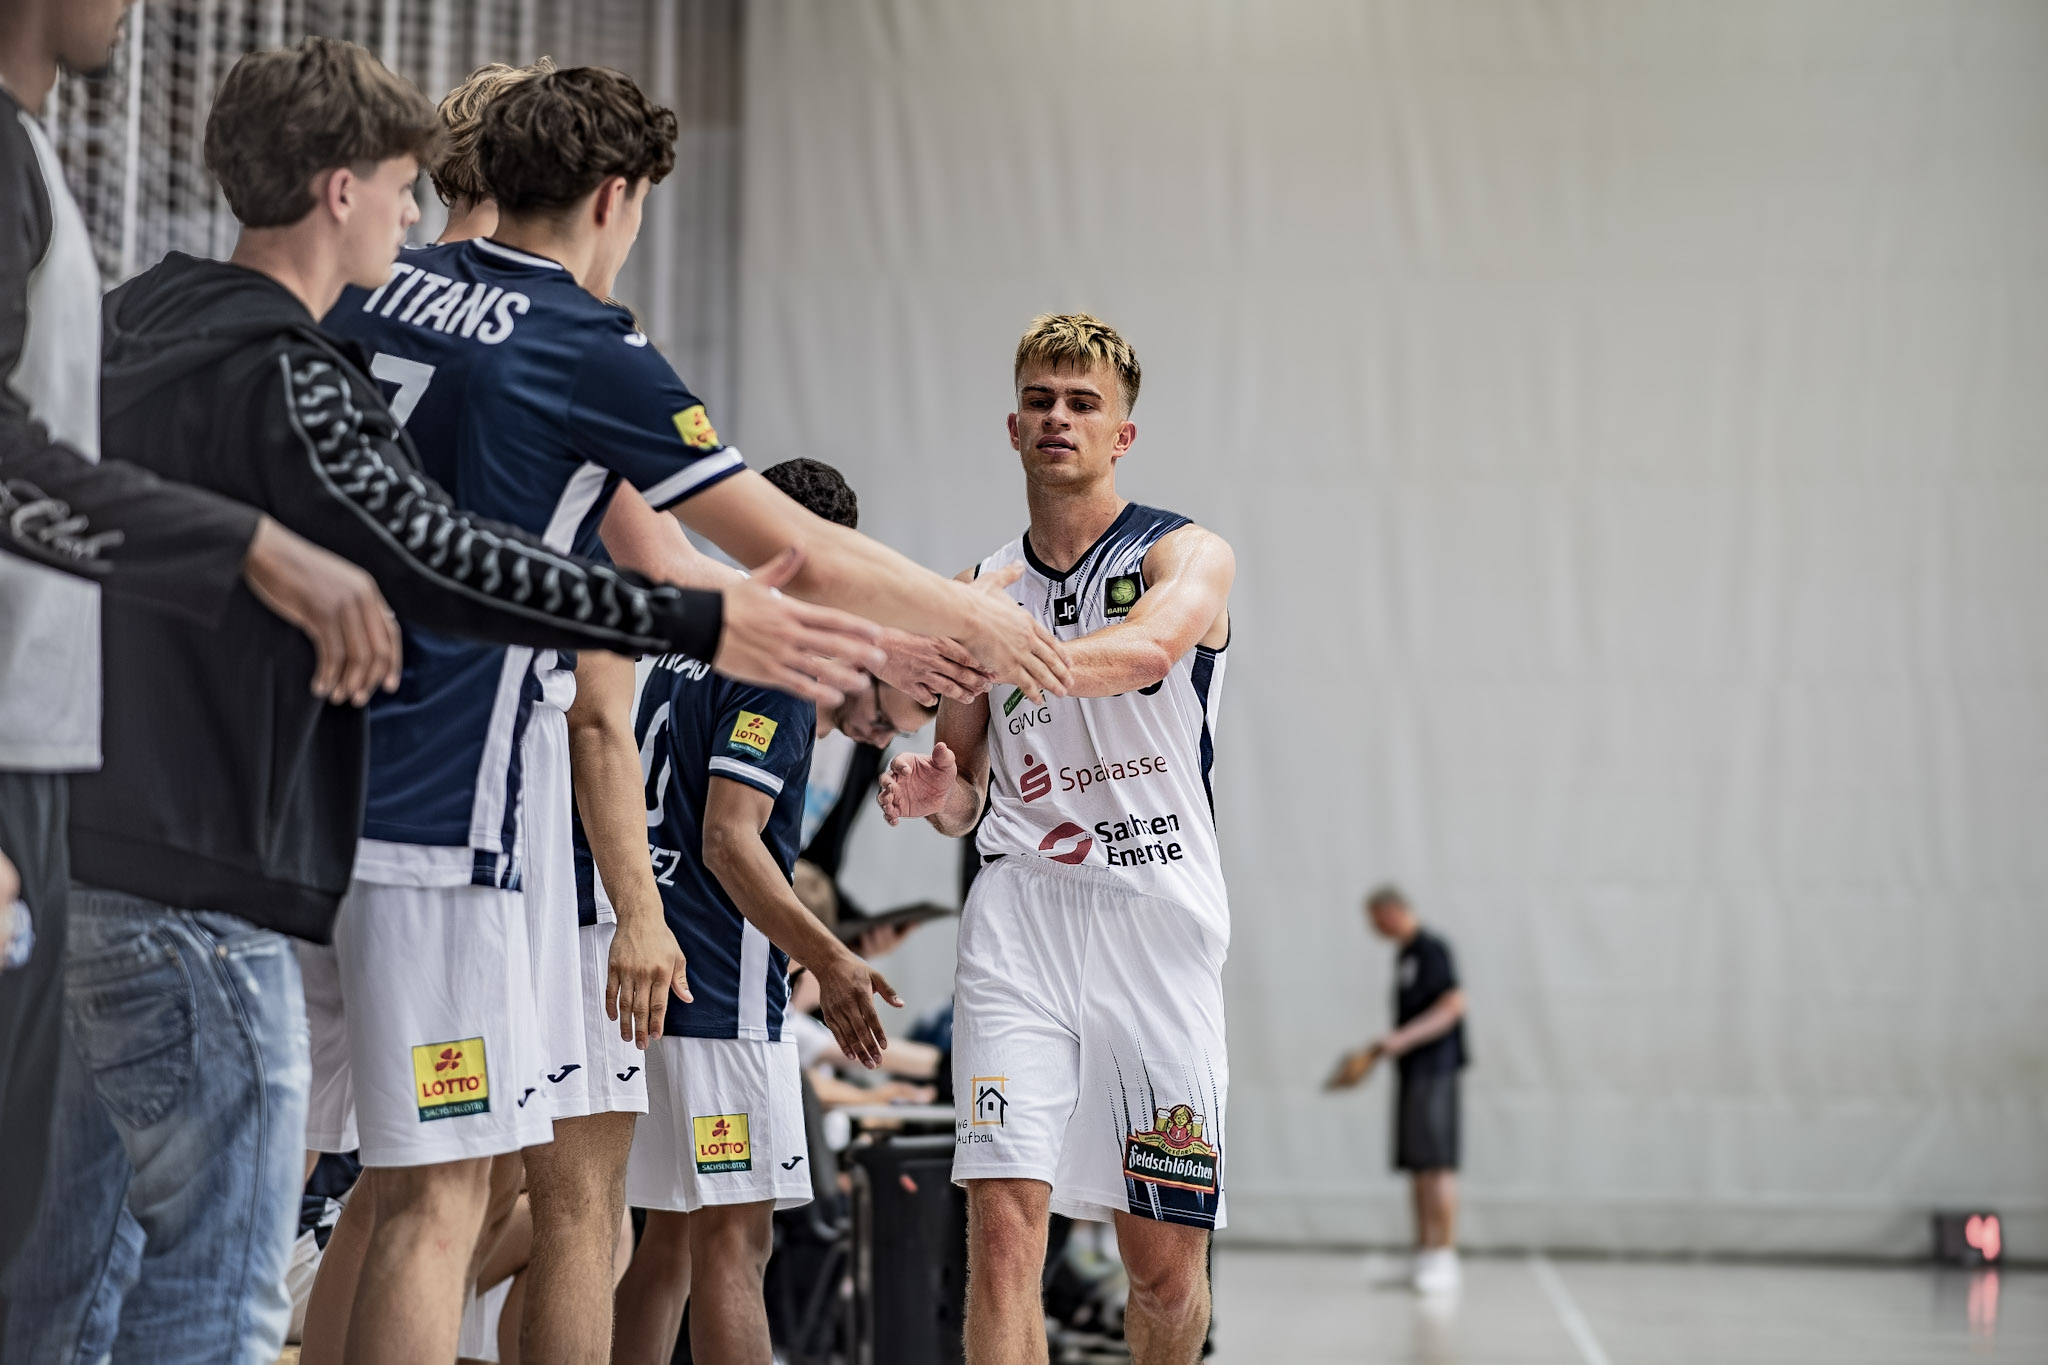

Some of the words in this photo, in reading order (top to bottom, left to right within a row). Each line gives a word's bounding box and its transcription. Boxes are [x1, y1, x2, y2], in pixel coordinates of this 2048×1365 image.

[362, 261, 531, 345] TITANS
[370, 351, 437, 427] 7
[1107, 605, 1133, 615] BARM
[1008, 706, 1052, 736] GWG
[735, 729, 766, 746] LOTTO
[1059, 755, 1168, 794] Spaasse
[422, 1076, 479, 1098] LOTTO
[700, 1142, 744, 1156] LOTTO
[956, 1131, 994, 1145] Aufbau
[1160, 1142, 1192, 1156] Dresdner
[1128, 1143, 1213, 1180] Feldschlößchen
